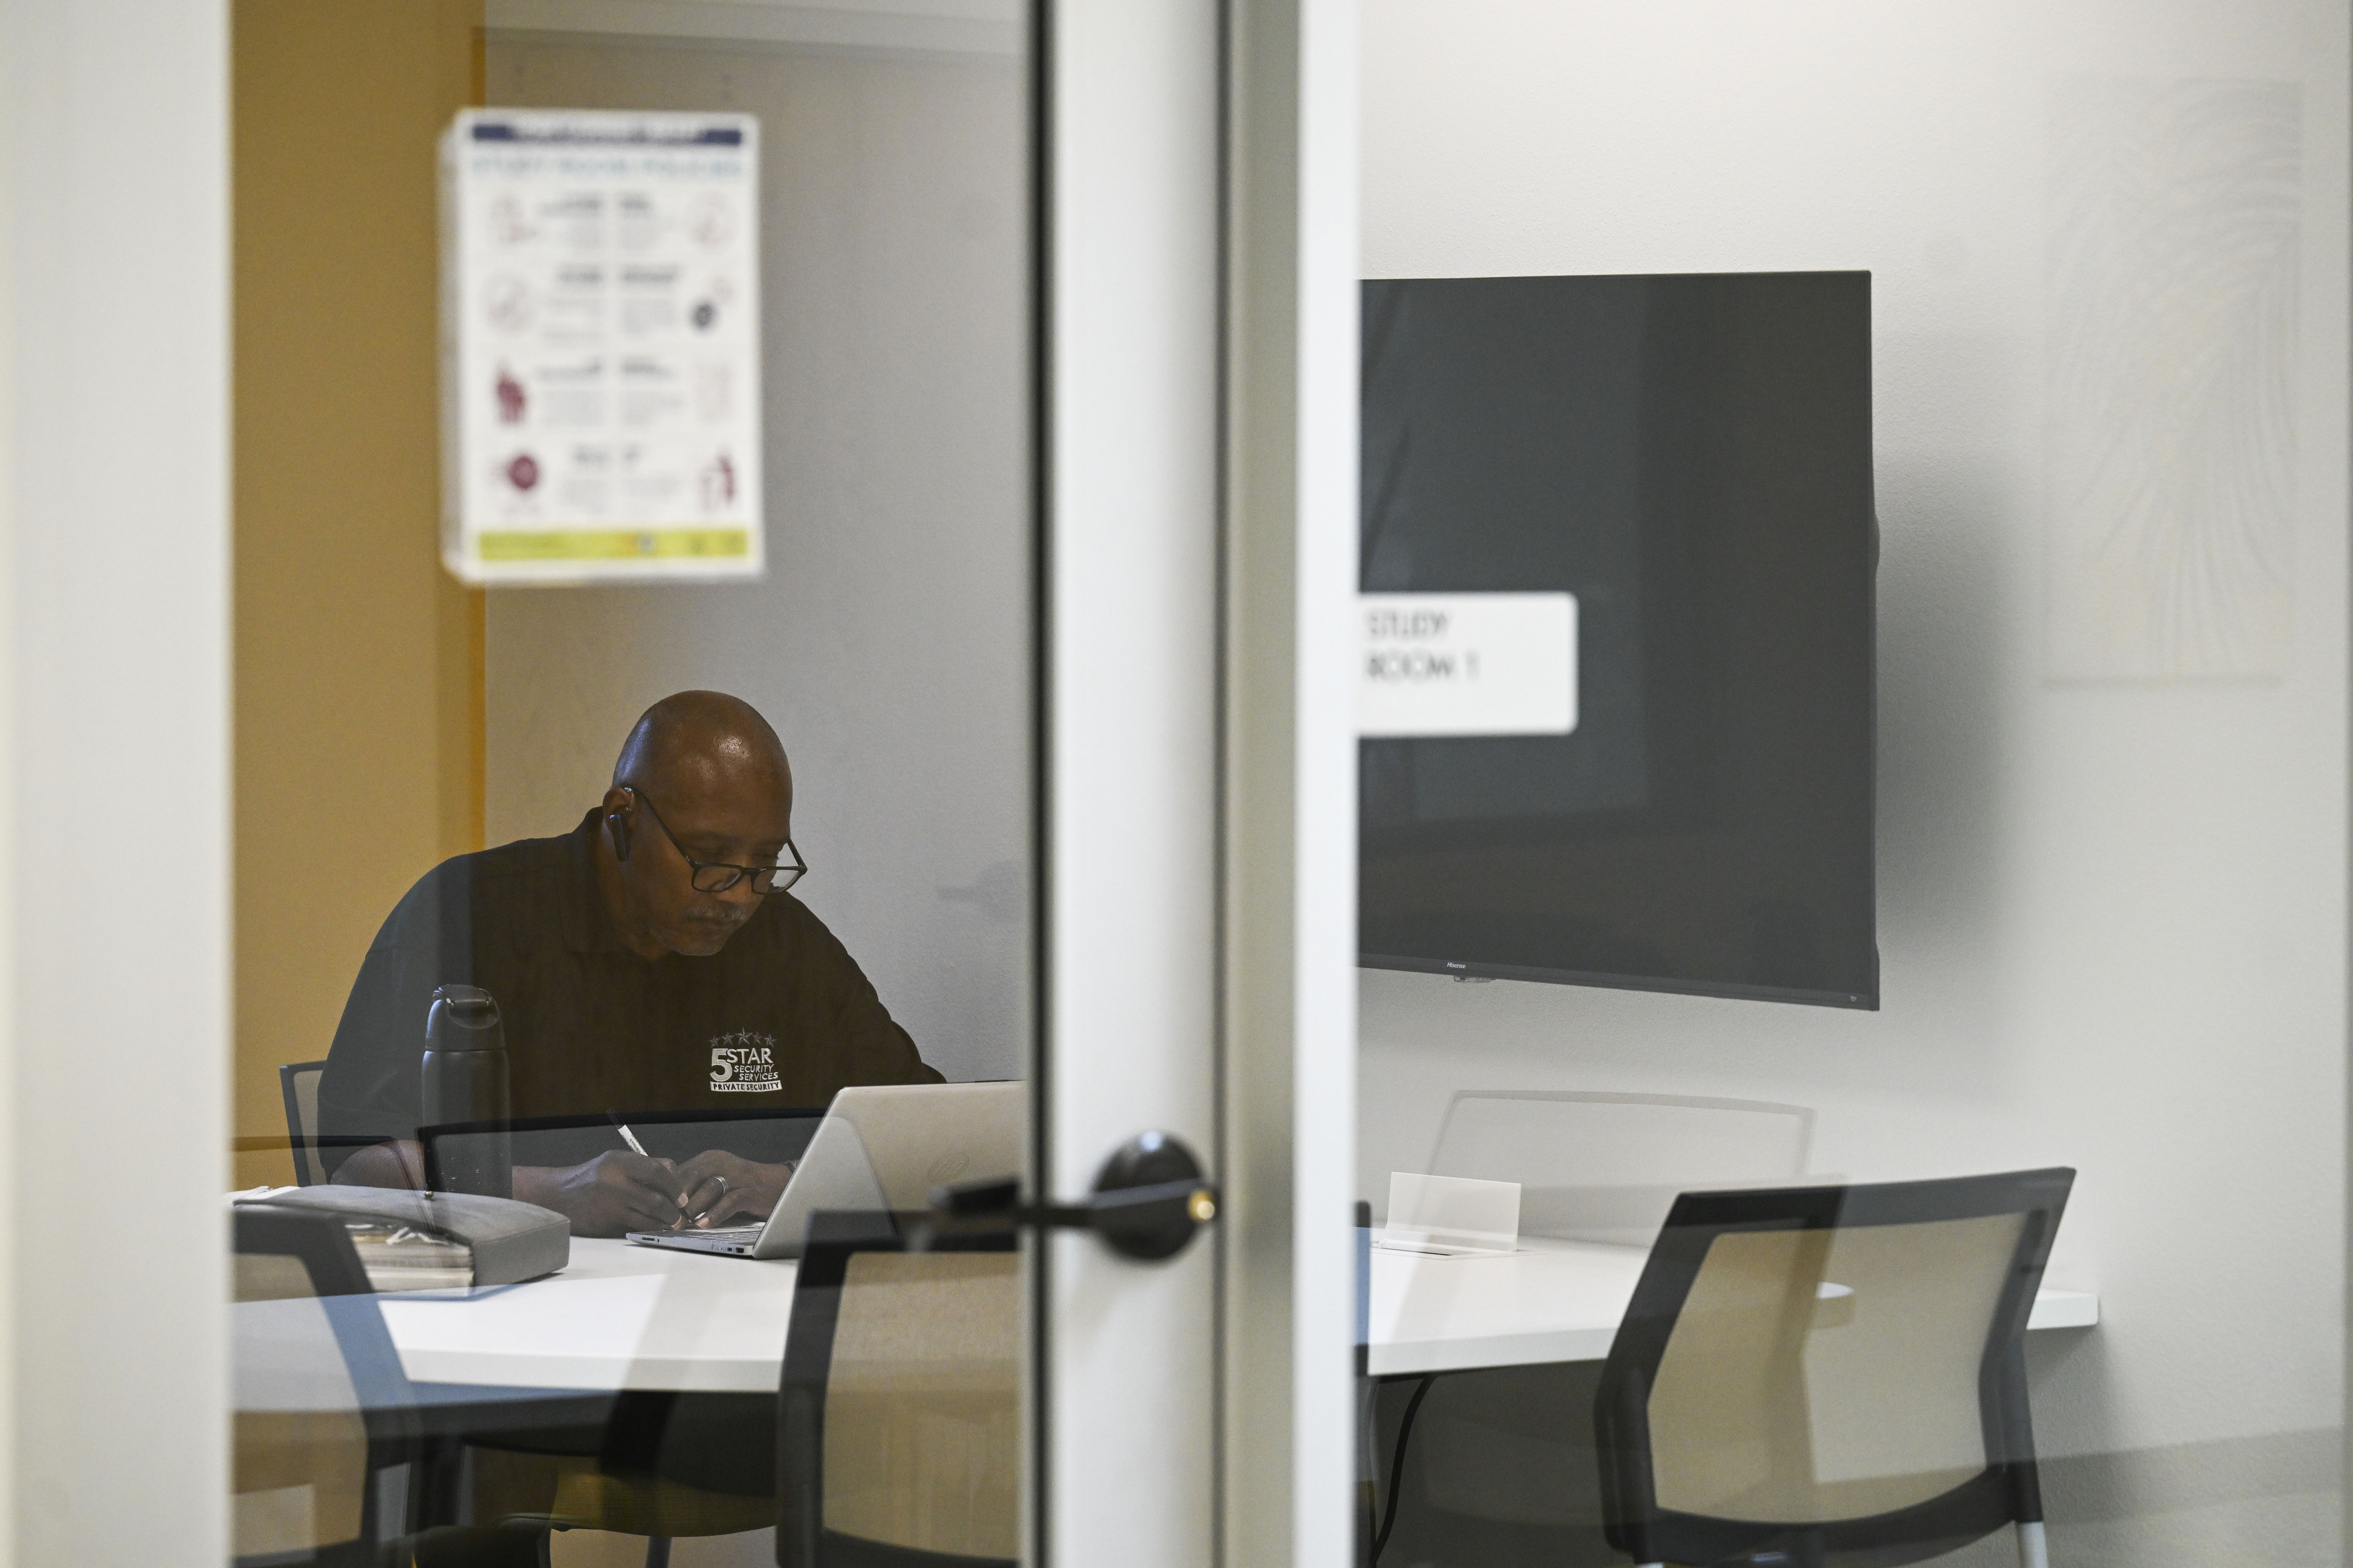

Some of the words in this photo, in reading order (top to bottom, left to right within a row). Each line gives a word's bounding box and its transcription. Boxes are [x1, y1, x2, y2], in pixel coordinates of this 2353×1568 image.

[1365, 608, 1449, 639] STUDY
[1365, 649, 1455, 681] ROOM
[734, 1064, 774, 1073] SECURITY
[738, 1072, 779, 1082] SERVICES
[746, 1082, 779, 1091] SECURITY
